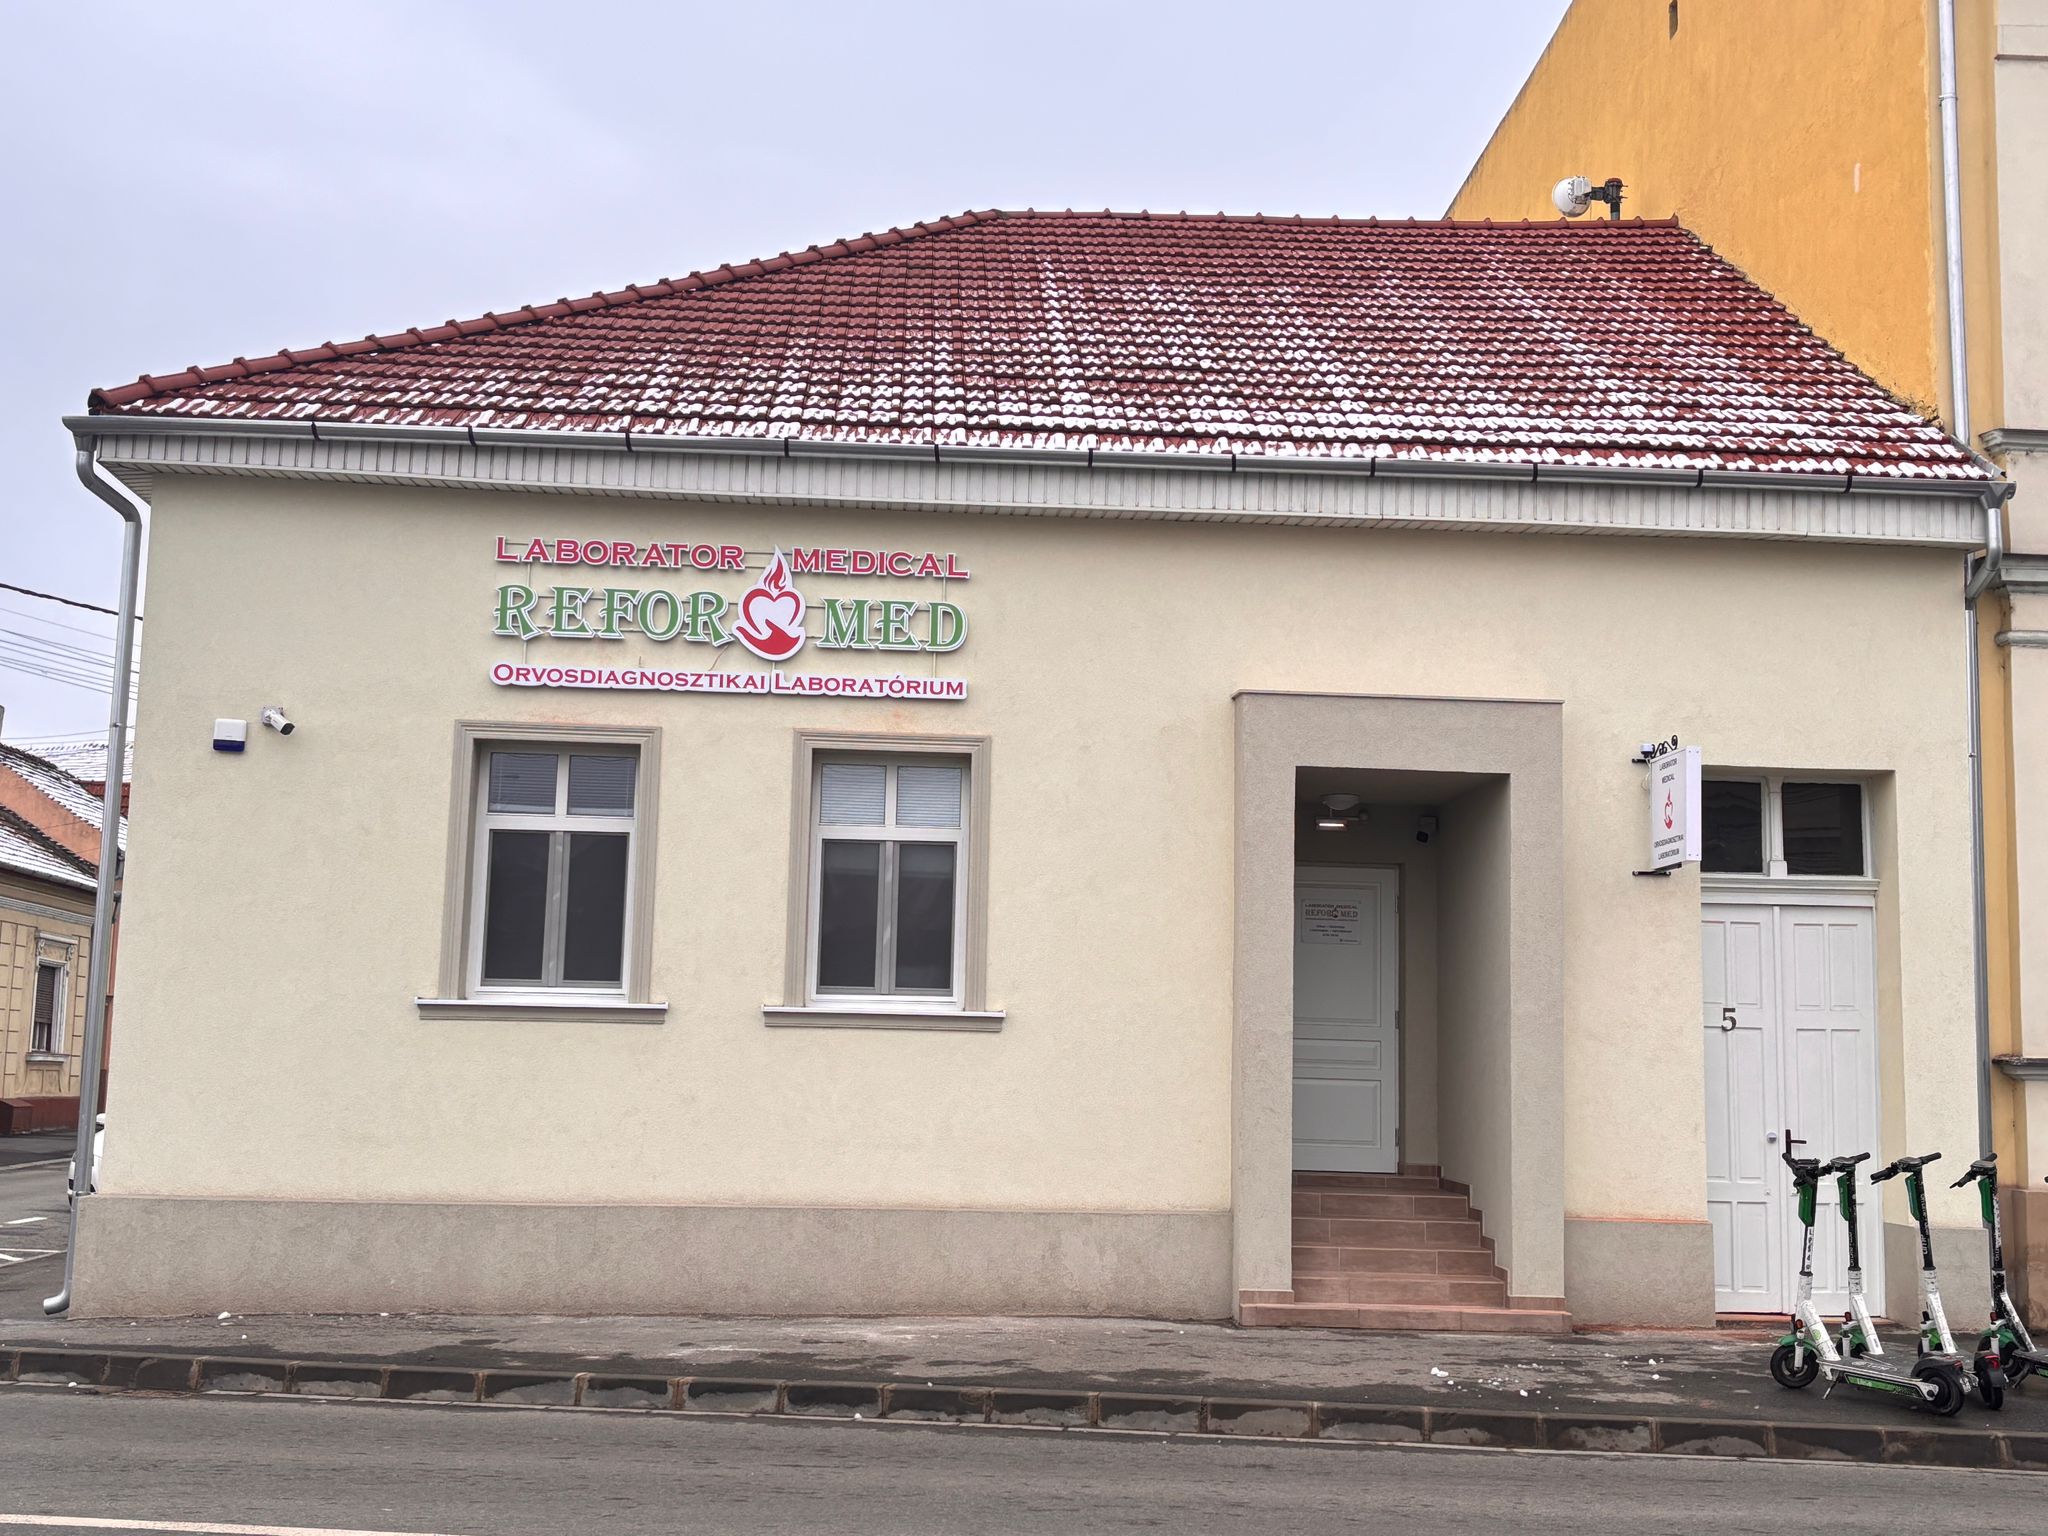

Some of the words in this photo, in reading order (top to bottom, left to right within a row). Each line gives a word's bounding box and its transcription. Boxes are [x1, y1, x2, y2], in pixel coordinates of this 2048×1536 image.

[495, 536, 745, 570] LABORATOR
[792, 546, 970, 579] MEDICAL
[493, 585, 735, 648] REFOR
[816, 597, 969, 652] MED
[493, 663, 766, 691] ORVOSDIAGNOSZTIKAI
[775, 669, 965, 697] LABORATÓRIUM
[1721, 1007, 1737, 1032] 5
